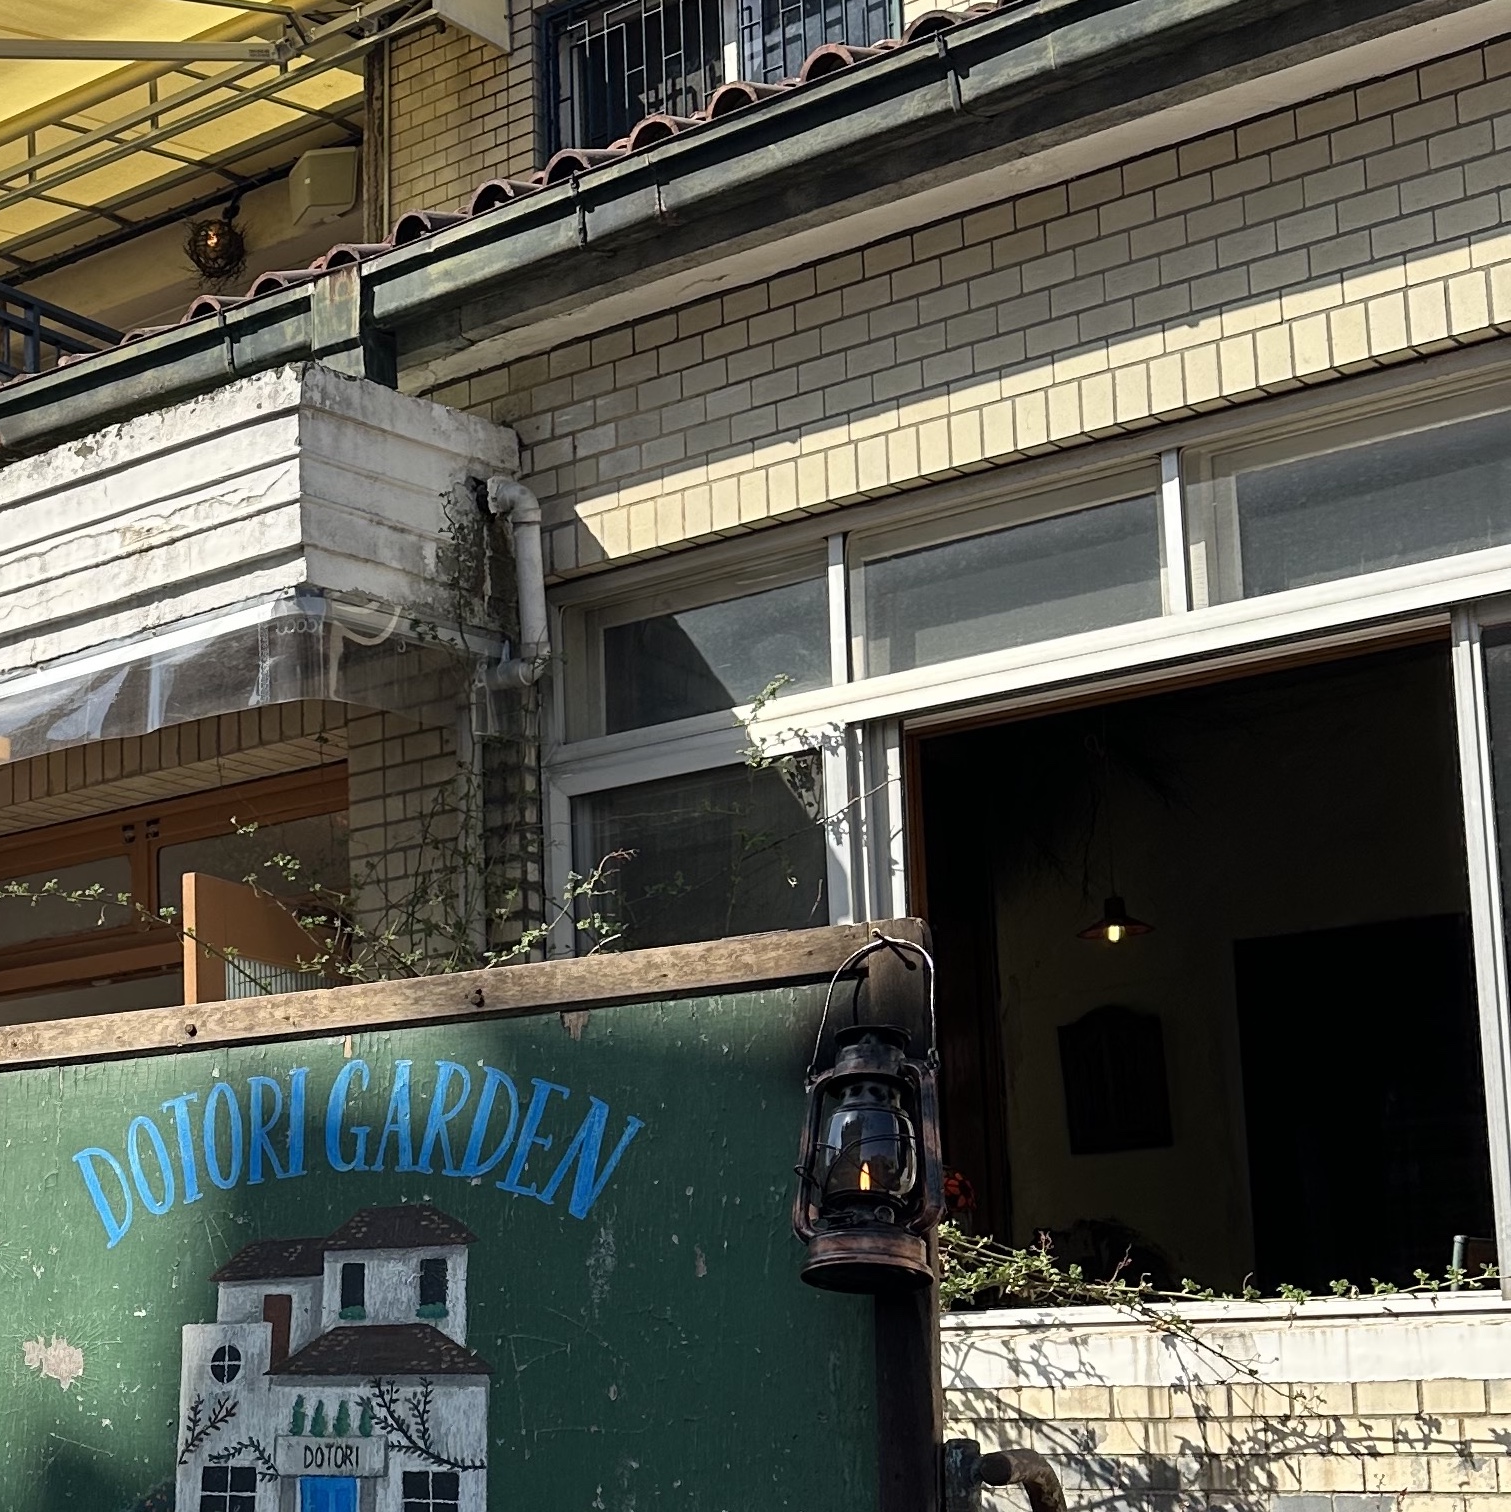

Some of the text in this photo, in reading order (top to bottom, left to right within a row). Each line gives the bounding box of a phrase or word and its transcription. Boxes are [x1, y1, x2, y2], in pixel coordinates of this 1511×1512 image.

[72, 1059, 644, 1249] DOTORI GARDEN
[303, 1443, 359, 1469] DOTORI
